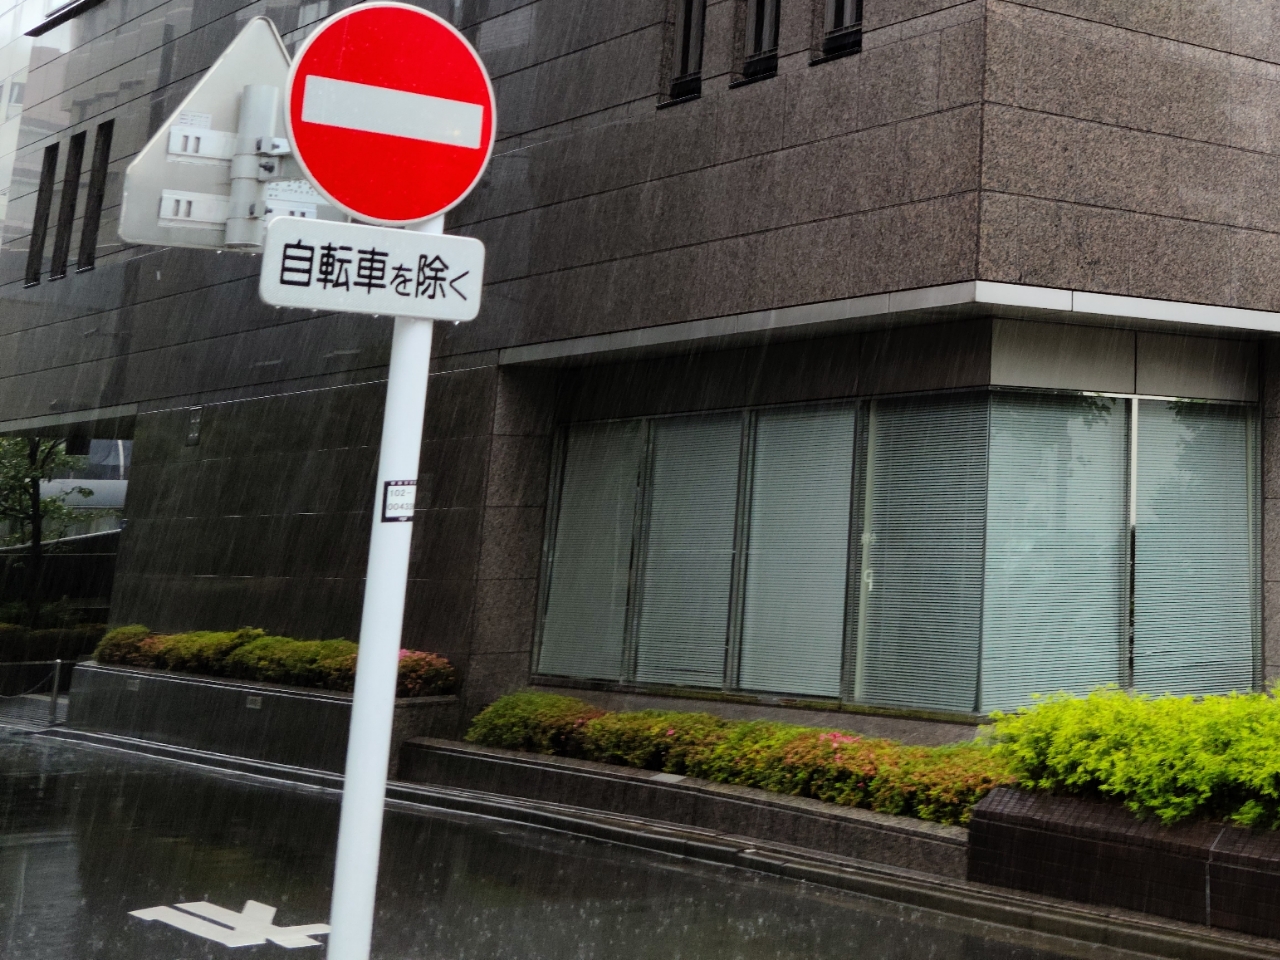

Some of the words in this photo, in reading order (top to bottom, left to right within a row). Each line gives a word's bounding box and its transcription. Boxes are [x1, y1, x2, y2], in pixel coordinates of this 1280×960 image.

[280, 239, 470, 301] 自転車を除く
